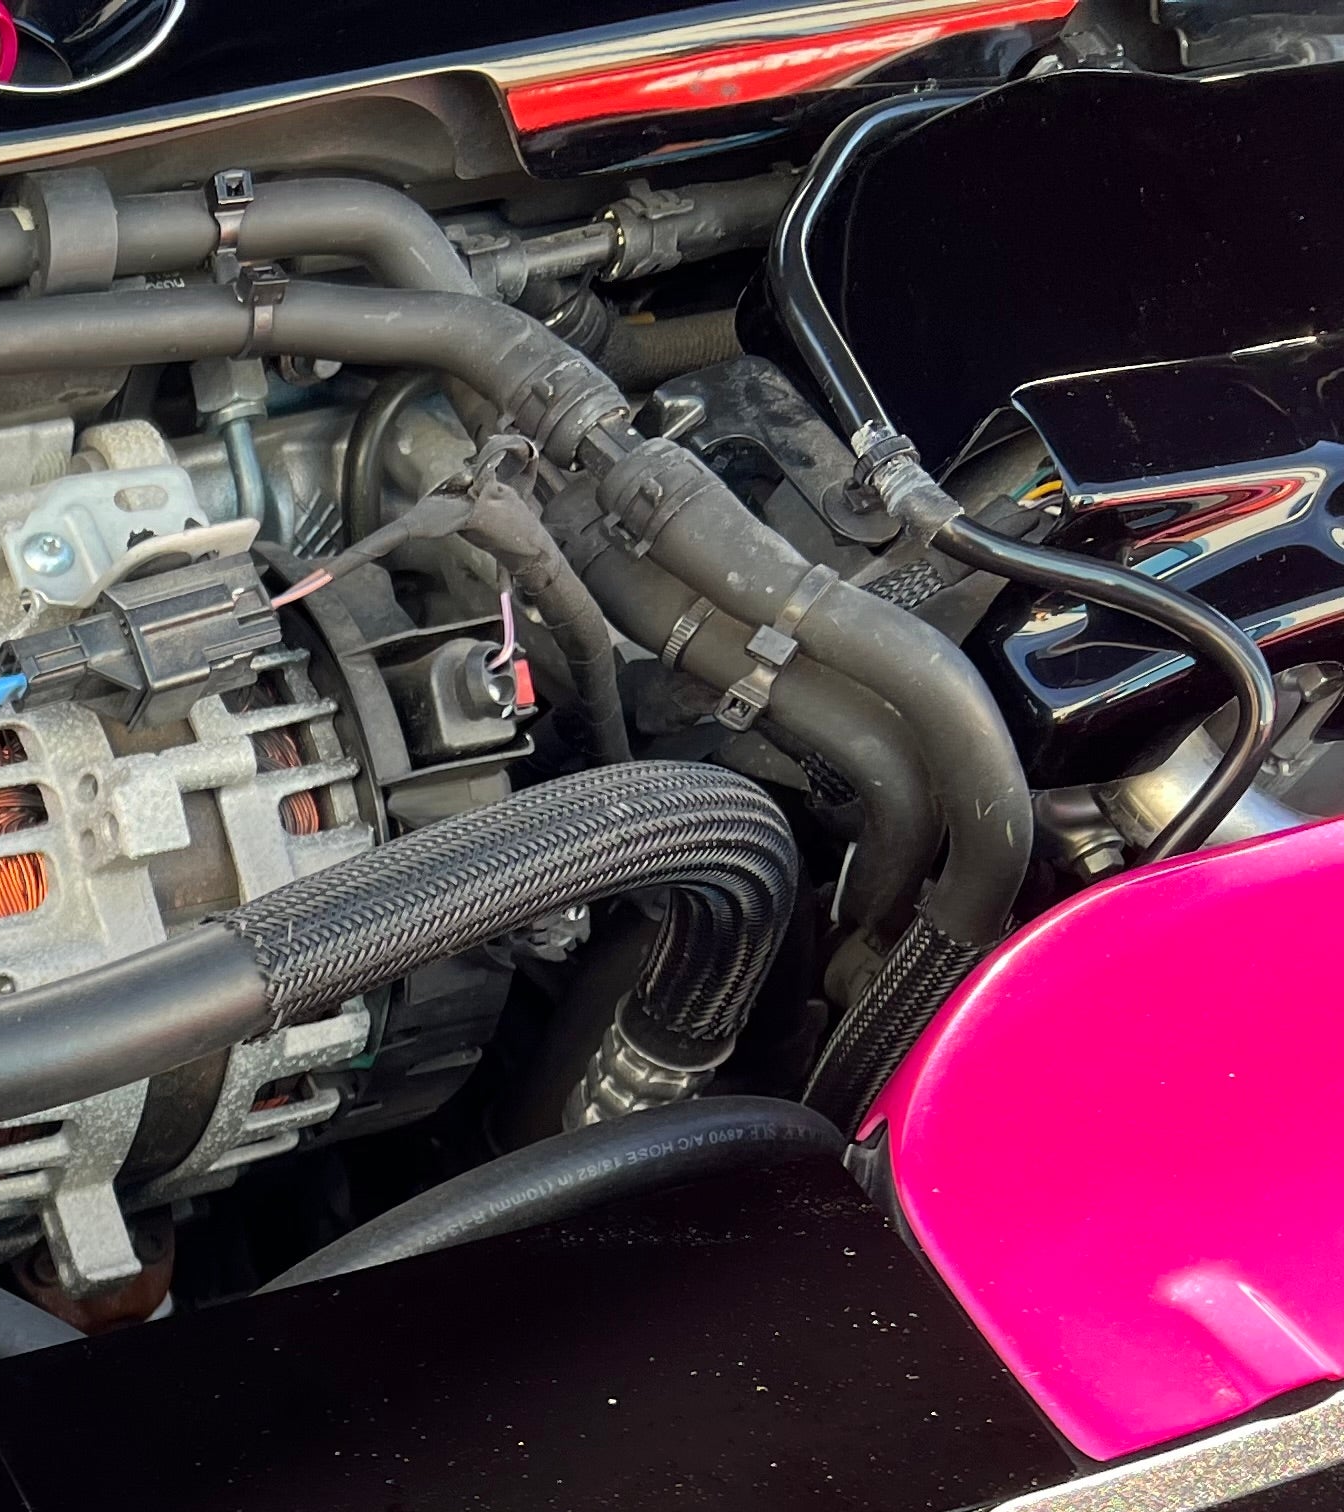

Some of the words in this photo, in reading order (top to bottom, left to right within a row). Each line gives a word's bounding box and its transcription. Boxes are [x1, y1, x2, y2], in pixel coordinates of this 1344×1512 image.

[678, 1133, 704, 1151] A/C
[708, 1128, 744, 1144] 4890
[626, 1140, 673, 1165] HOSE
[489, 1178, 553, 1216] (10mm)
